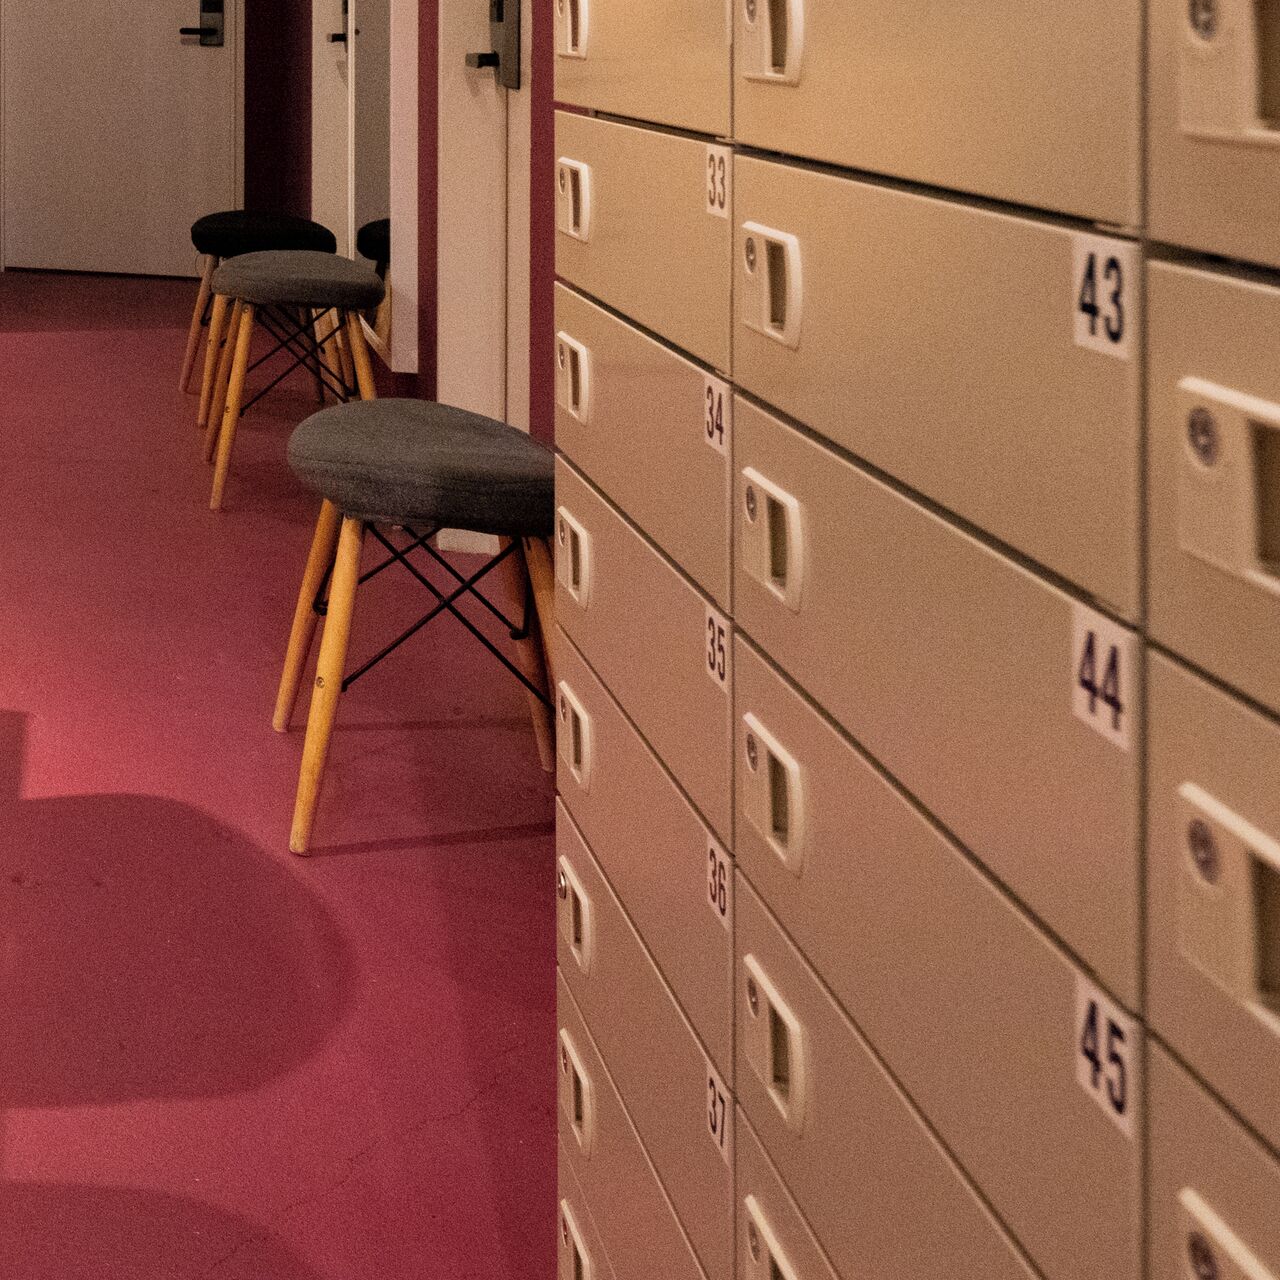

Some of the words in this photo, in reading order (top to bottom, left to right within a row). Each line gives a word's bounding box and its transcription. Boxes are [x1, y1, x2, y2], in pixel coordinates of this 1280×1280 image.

[708, 153, 726, 209] 33
[1079, 252, 1124, 343] 43
[706, 385, 724, 446] 34
[708, 616, 726, 681] 35
[1079, 631, 1122, 730] 44
[709, 847, 727, 917] 36
[1081, 1000, 1126, 1108] 45
[708, 1077, 726, 1148] 37
